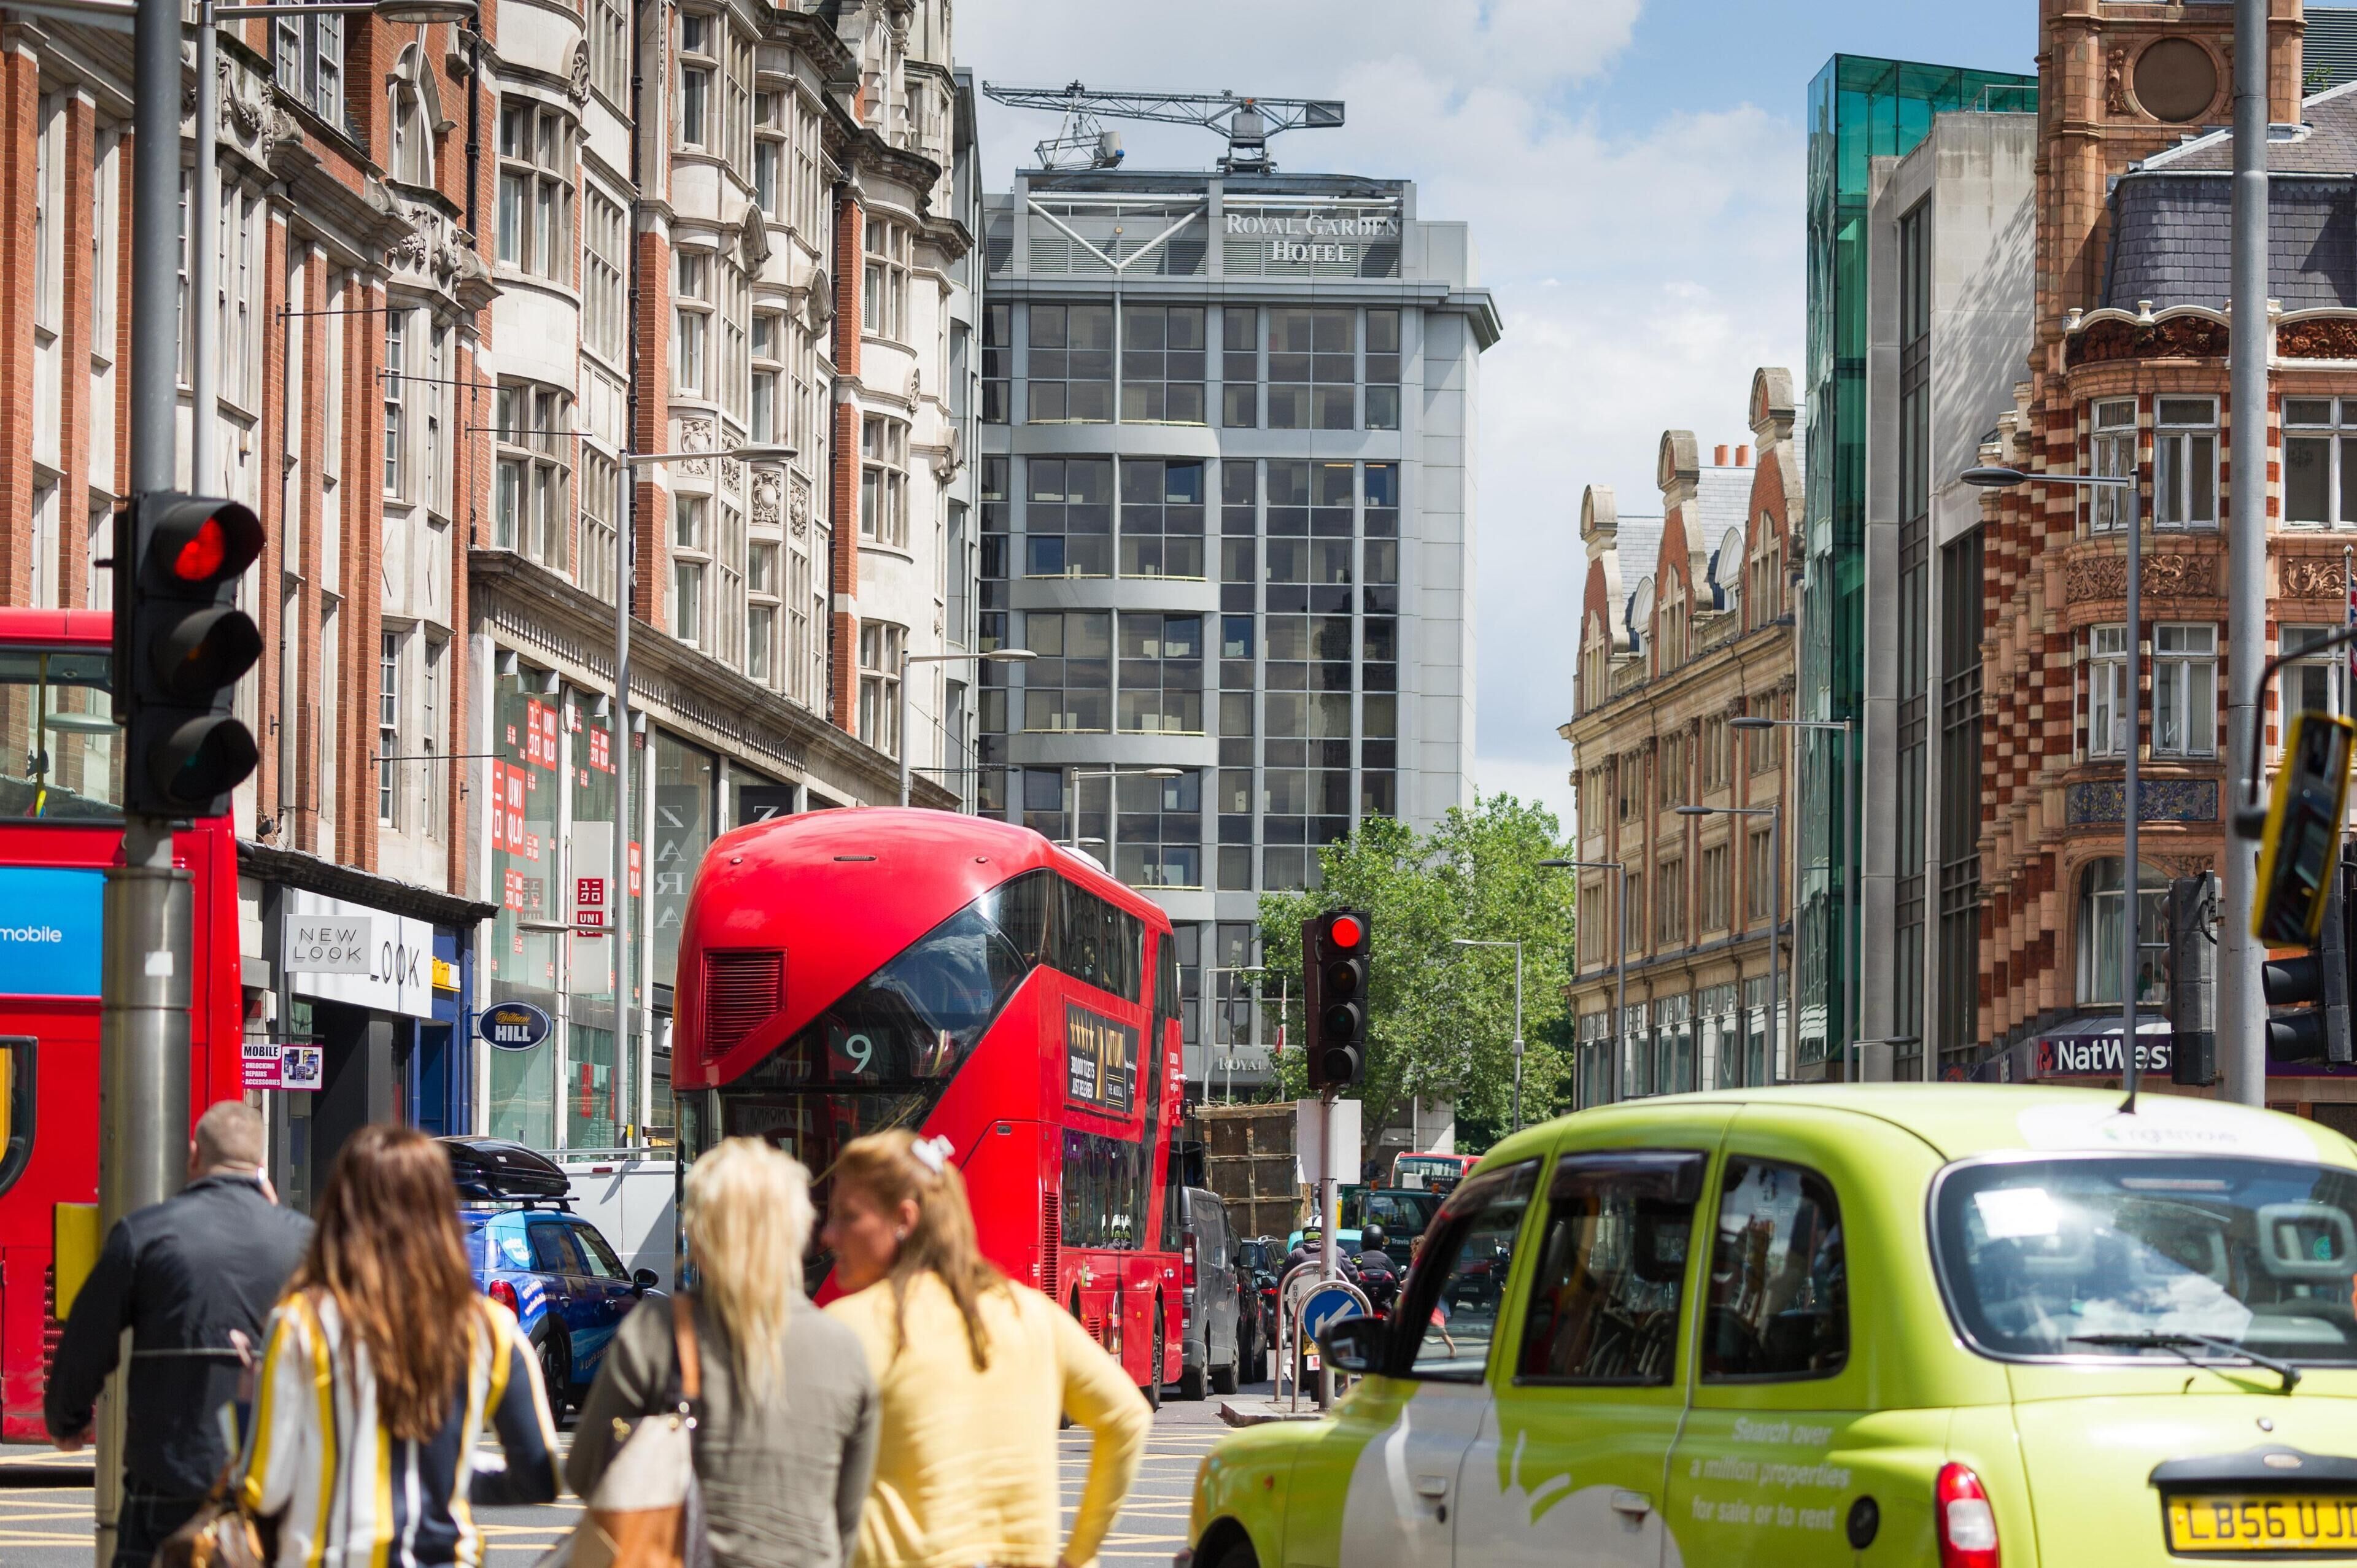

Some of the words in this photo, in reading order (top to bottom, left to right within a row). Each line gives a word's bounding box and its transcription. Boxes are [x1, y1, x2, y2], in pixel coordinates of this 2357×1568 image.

[1226, 214, 1299, 234] ROYAL
[1306, 215, 1400, 236] GARDEN
[1271, 241, 1350, 261] HOTEL
[508, 776, 522, 809] UNI
[508, 813, 522, 848] QLO
[630, 848, 639, 868] UNI
[581, 881, 600, 890] ユニ
[579, 914, 599, 924] UNI
[0, 925, 62, 943] mobile
[300, 927, 357, 942] NEW
[295, 946, 362, 960] LOOK
[495, 1011, 532, 1025] William
[495, 1025, 531, 1041] HILL
[244, 1046, 278, 1057] MOBILE
[846, 1034, 872, 1073] 9
[1218, 1057, 1264, 1070] ROYAL
[1733, 1416, 1789, 1442] Search
[1792, 1426, 1832, 1445] over
[1690, 1458, 1700, 1478] a
[1703, 1455, 1758, 1481] million
[1759, 1461, 1851, 1491] properties
[1692, 1495, 1714, 1520] for
[1717, 1499, 1750, 1524] sale
[1754, 1505, 1773, 1524] or
[1777, 1502, 1794, 1526] to
[1798, 1506, 1836, 1530] rent
[2186, 1502, 2285, 1539] LB56
